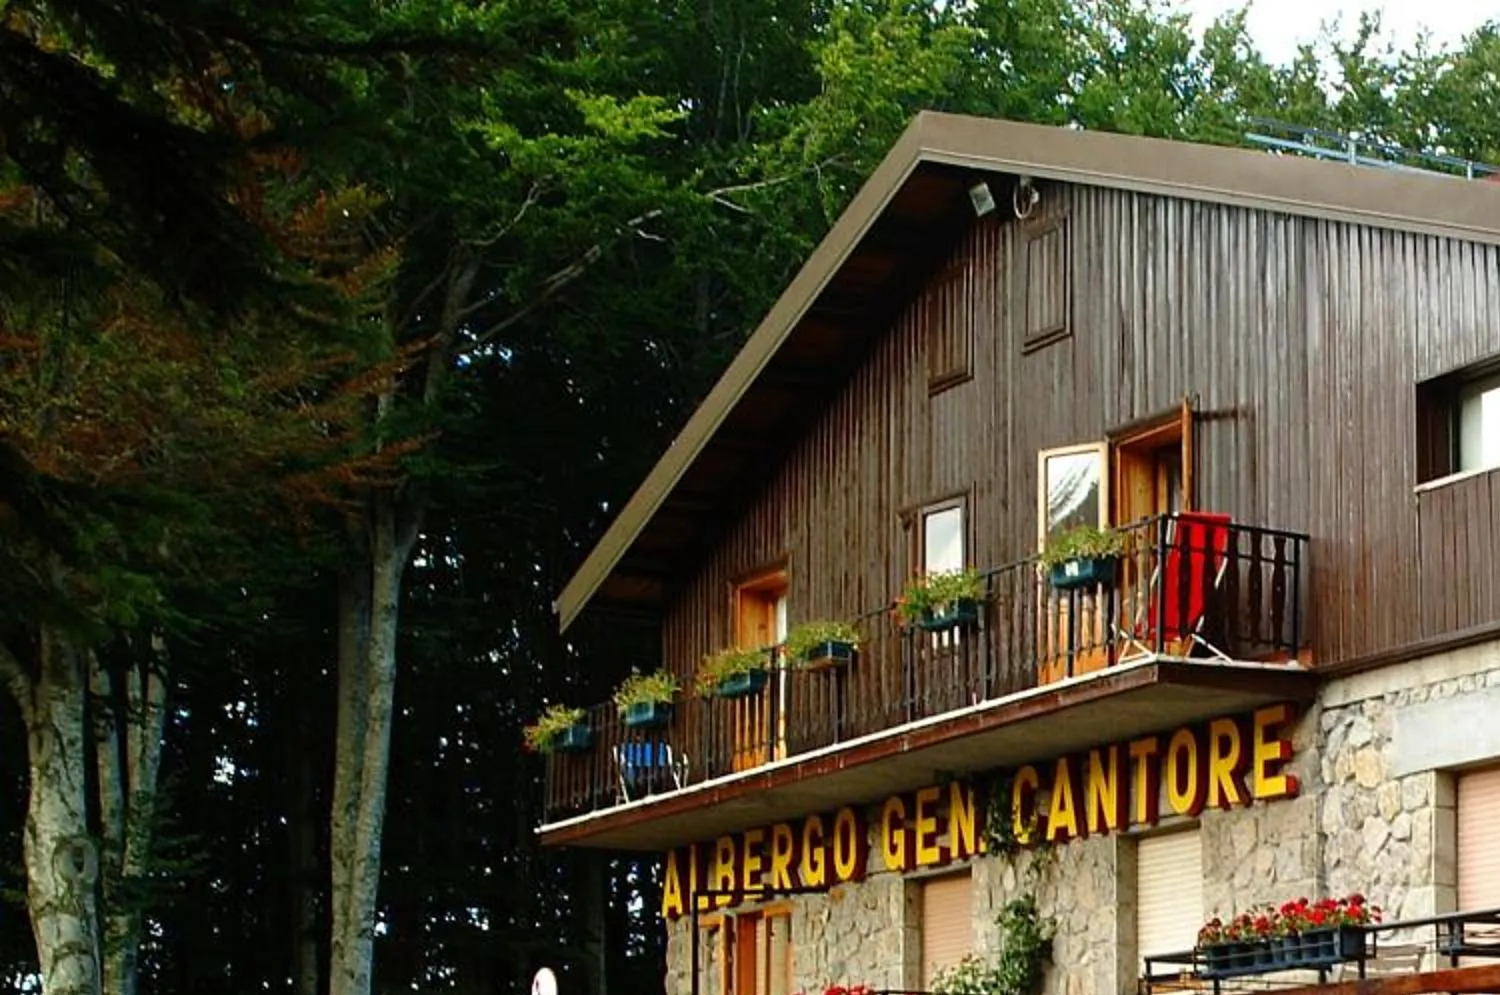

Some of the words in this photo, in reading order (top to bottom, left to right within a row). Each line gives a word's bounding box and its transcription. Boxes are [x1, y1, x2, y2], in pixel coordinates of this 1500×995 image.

[661, 806, 859, 918] ALBERGO
[881, 780, 988, 872] GEN.
[1013, 702, 1292, 846] CANTORE
